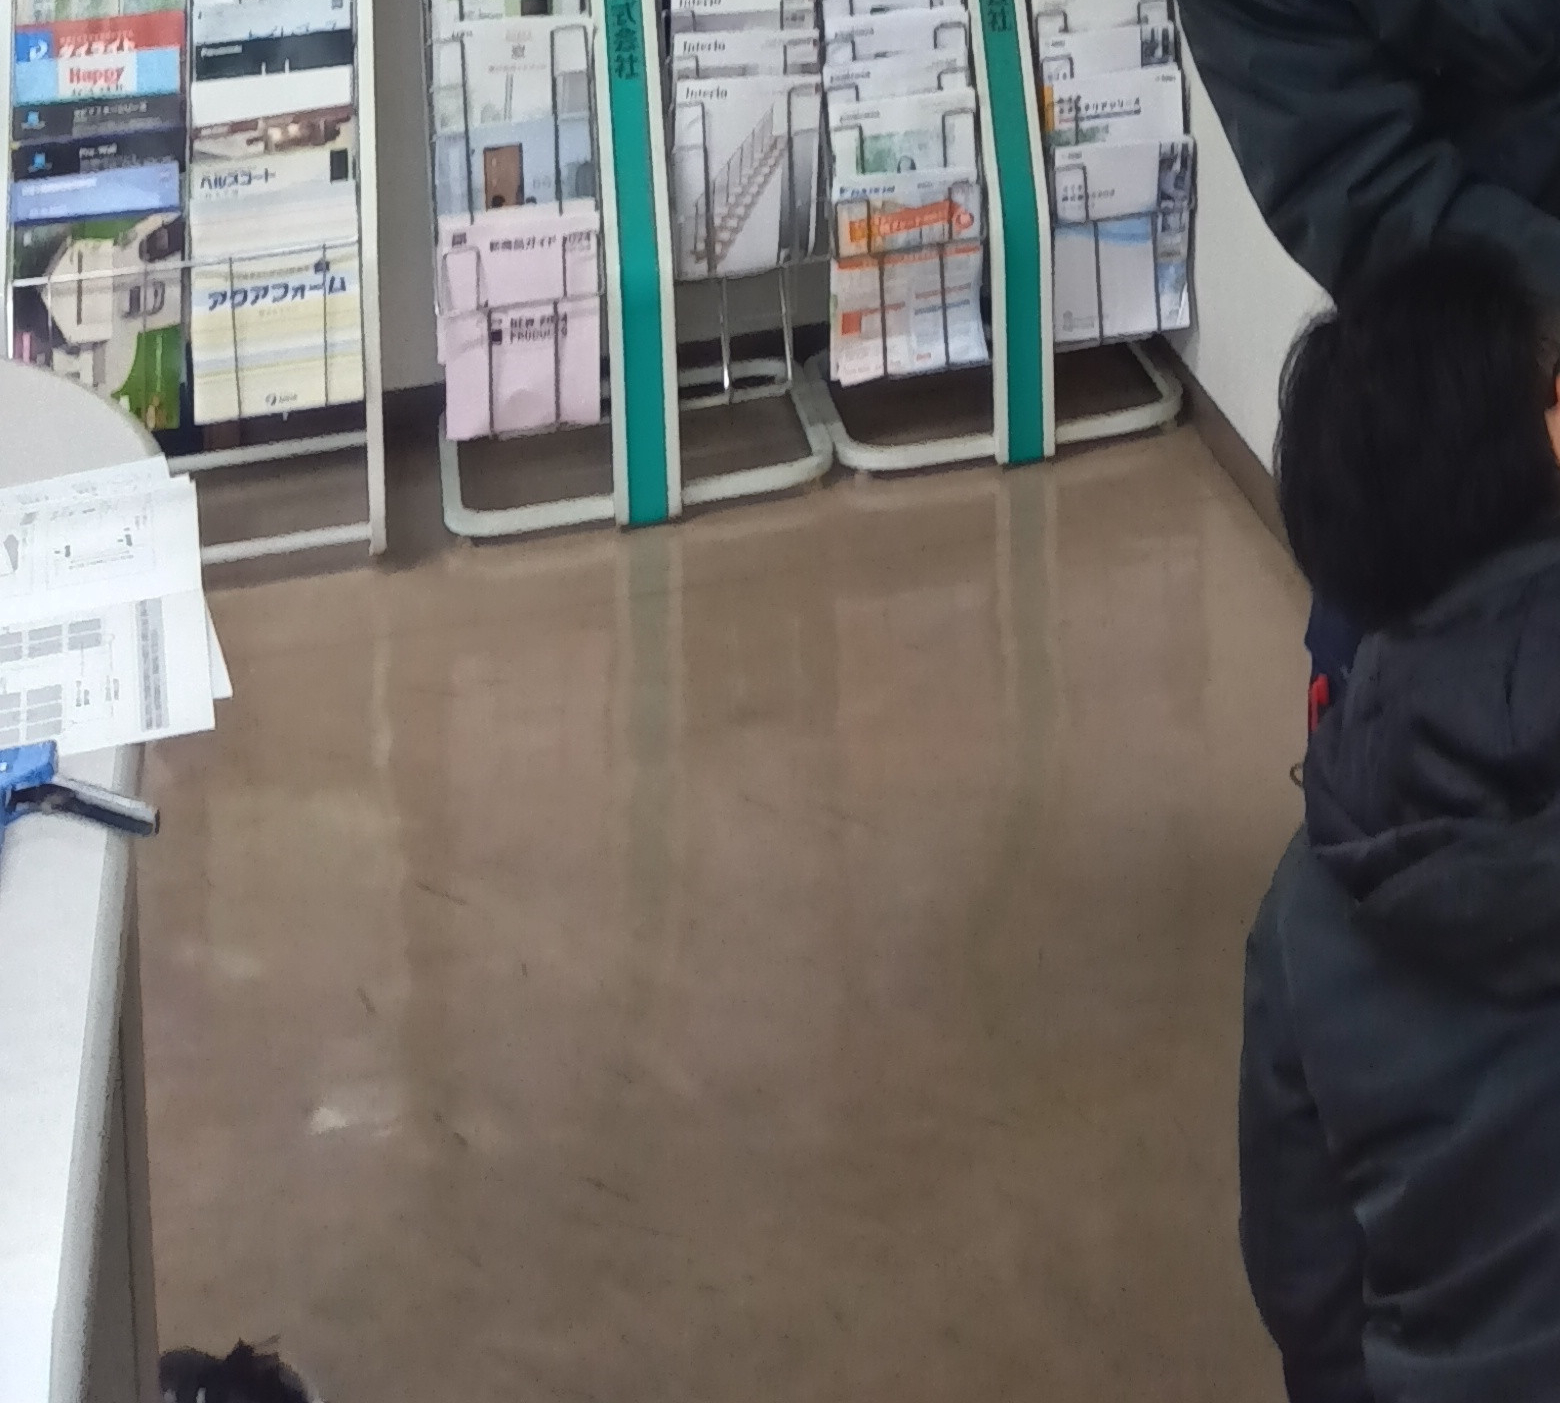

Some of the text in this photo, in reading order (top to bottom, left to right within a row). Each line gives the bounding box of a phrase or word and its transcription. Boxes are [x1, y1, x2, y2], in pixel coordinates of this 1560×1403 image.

[208, 275, 347, 312] アクアフォーム
